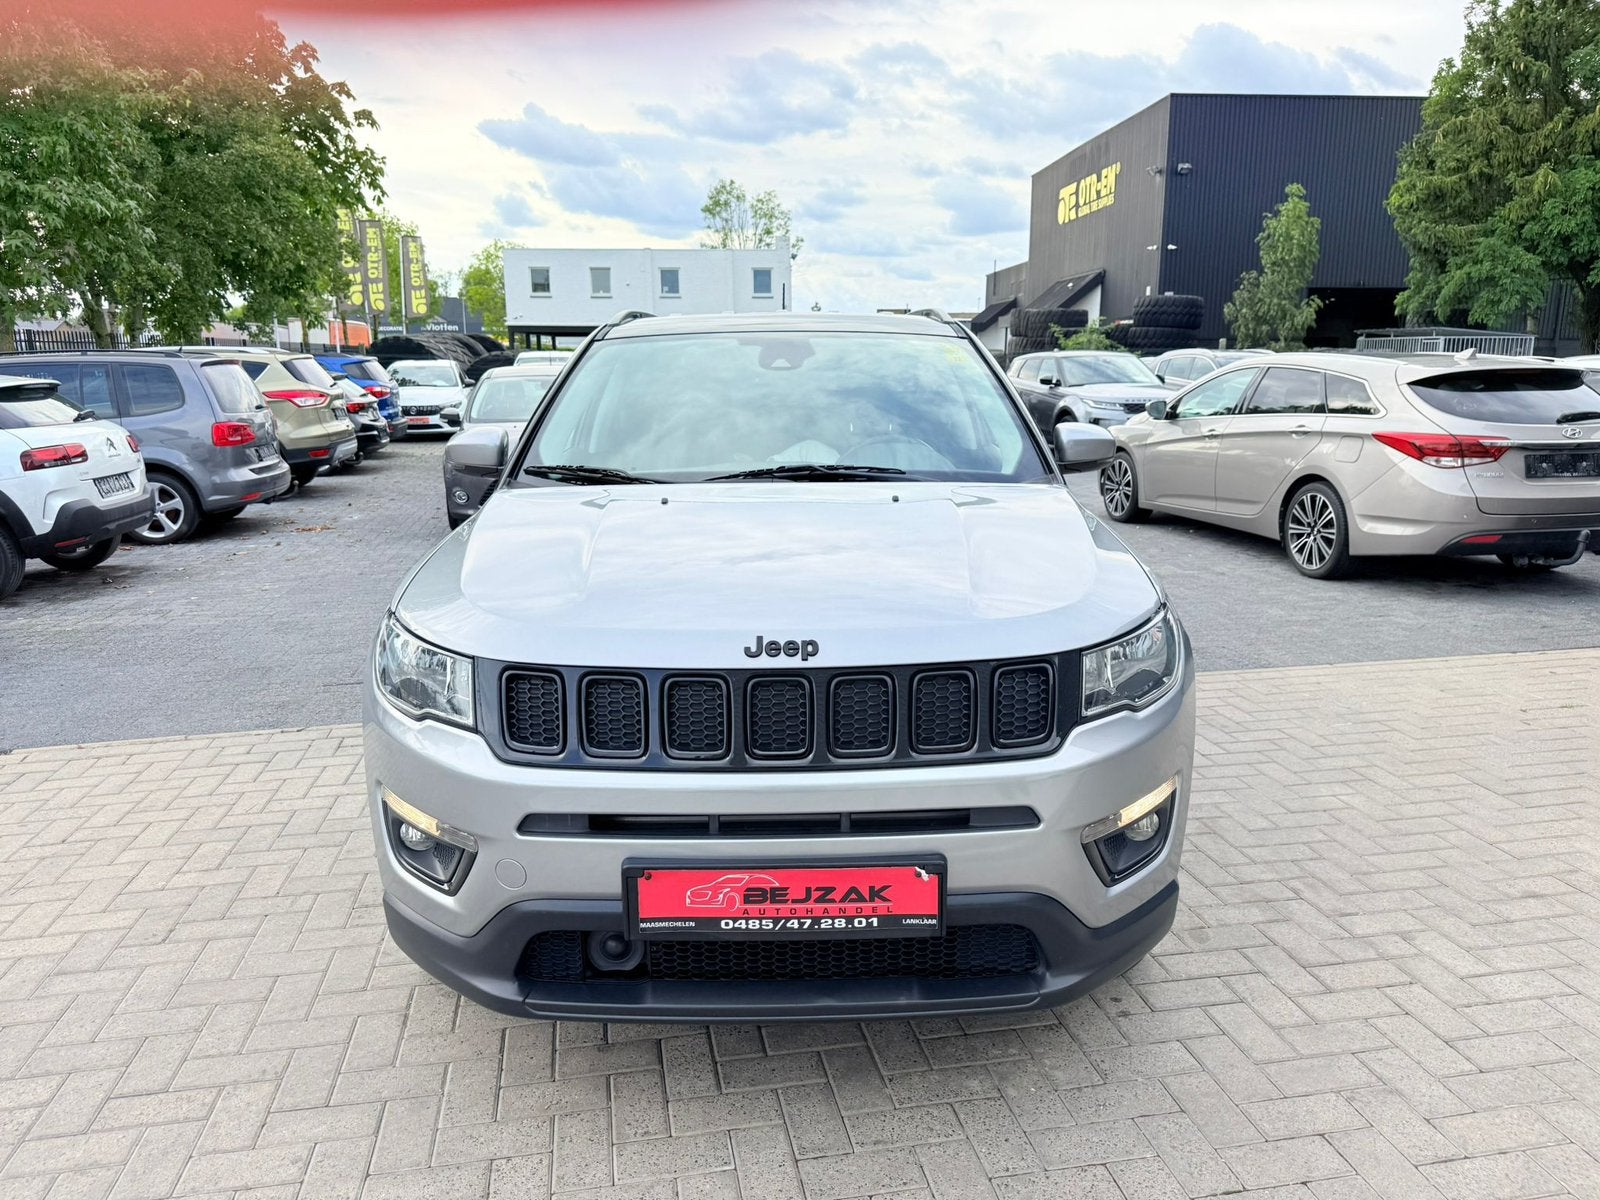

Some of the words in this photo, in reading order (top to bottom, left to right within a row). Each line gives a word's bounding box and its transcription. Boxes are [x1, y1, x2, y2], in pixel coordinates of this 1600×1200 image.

[744, 635, 819, 661] Jeep
[744, 885, 893, 904] BEJZAK
[743, 906, 893, 915] AUTOHANDEL
[720, 917, 878, 930] 0485/47.28.01
